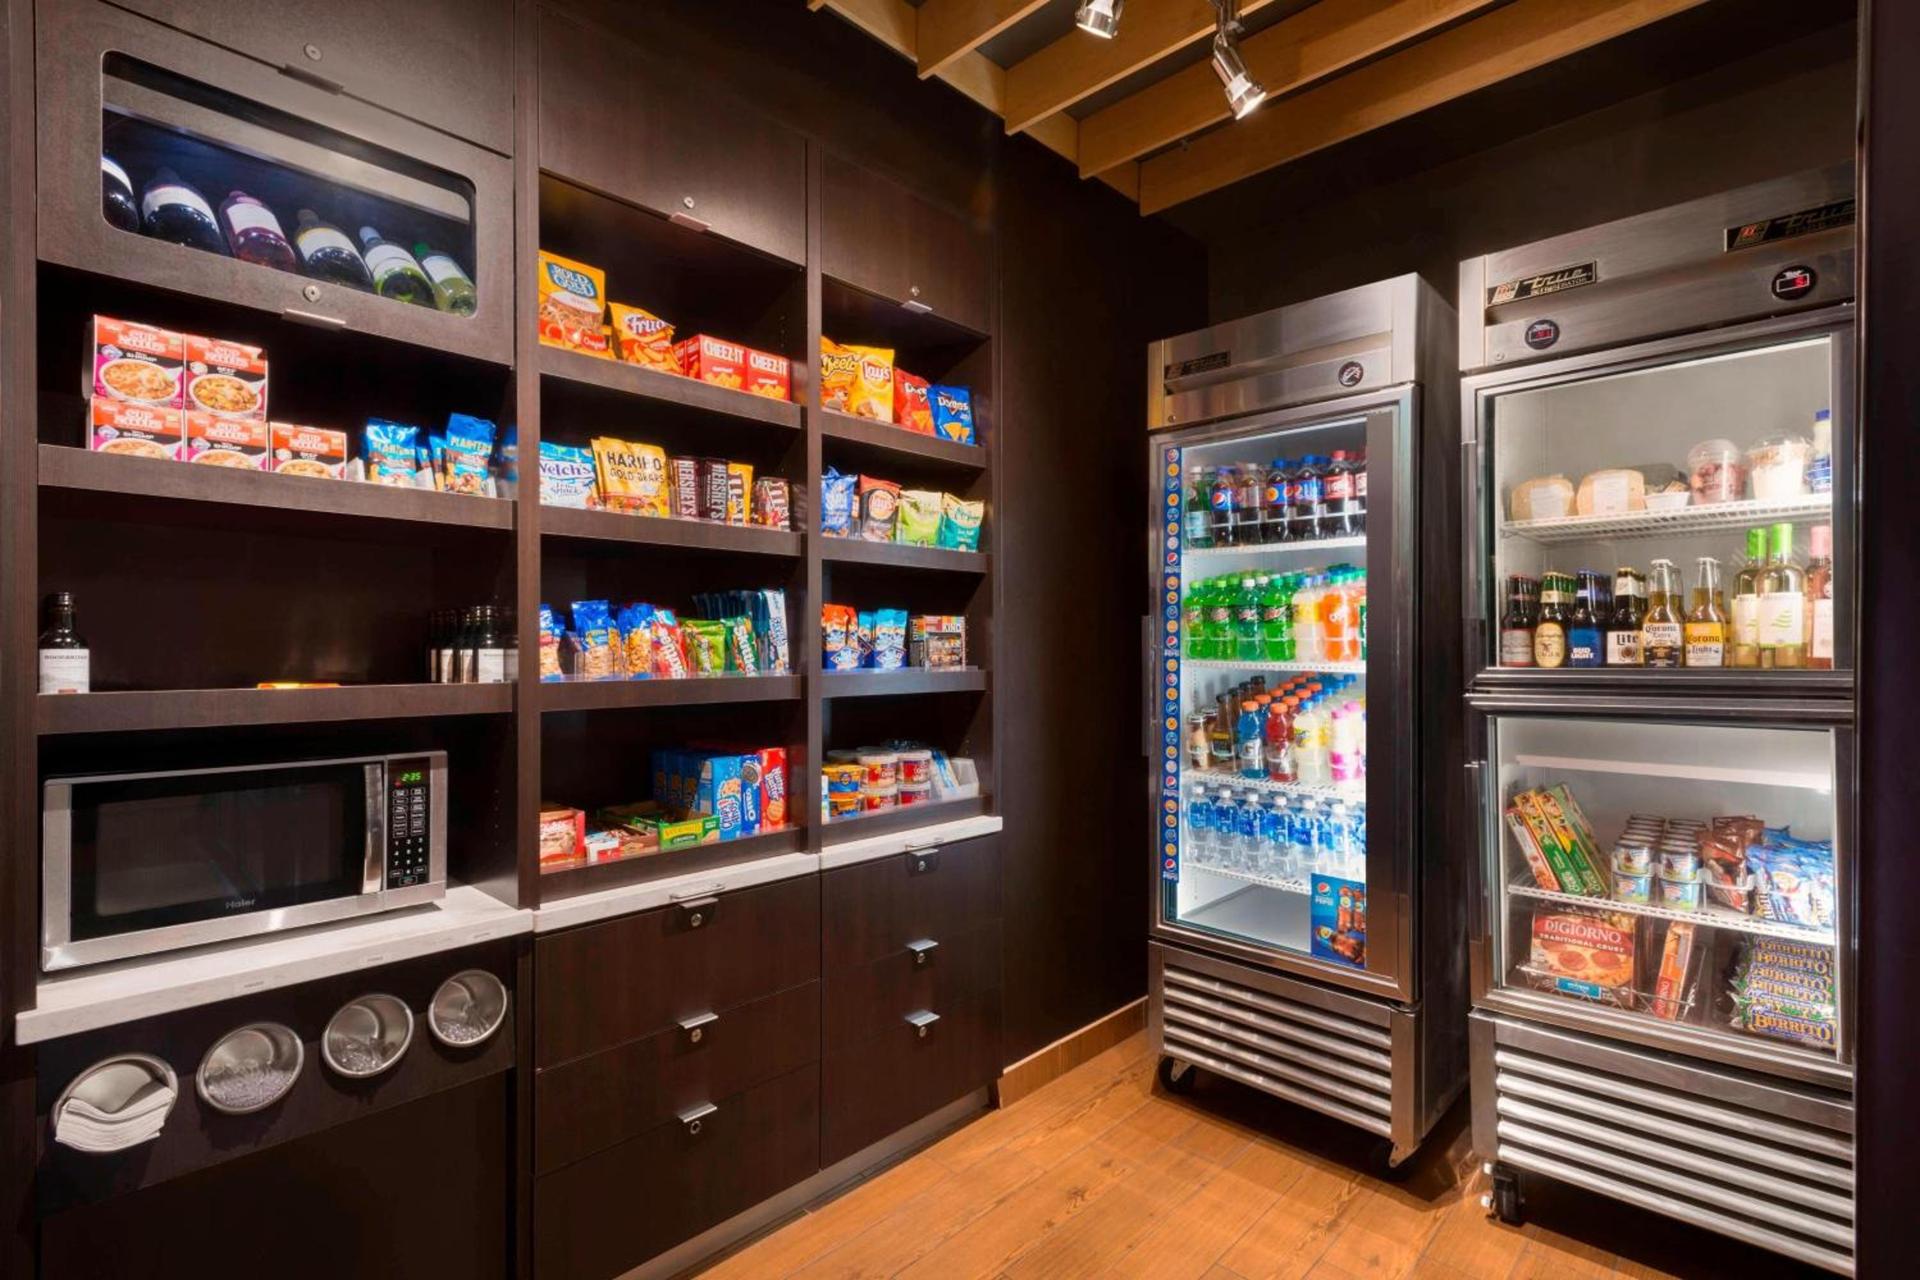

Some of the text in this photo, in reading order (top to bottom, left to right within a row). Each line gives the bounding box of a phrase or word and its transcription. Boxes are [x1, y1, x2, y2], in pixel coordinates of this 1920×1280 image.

[679, 460, 697, 521] HERSHEY'S
[711, 463, 727, 521] HERSHEY'S
[226, 897, 256, 910] Haier
[1539, 933, 1625, 953] TRADITIONAL CRUST
[1755, 1013, 1832, 1041] BURRITO
